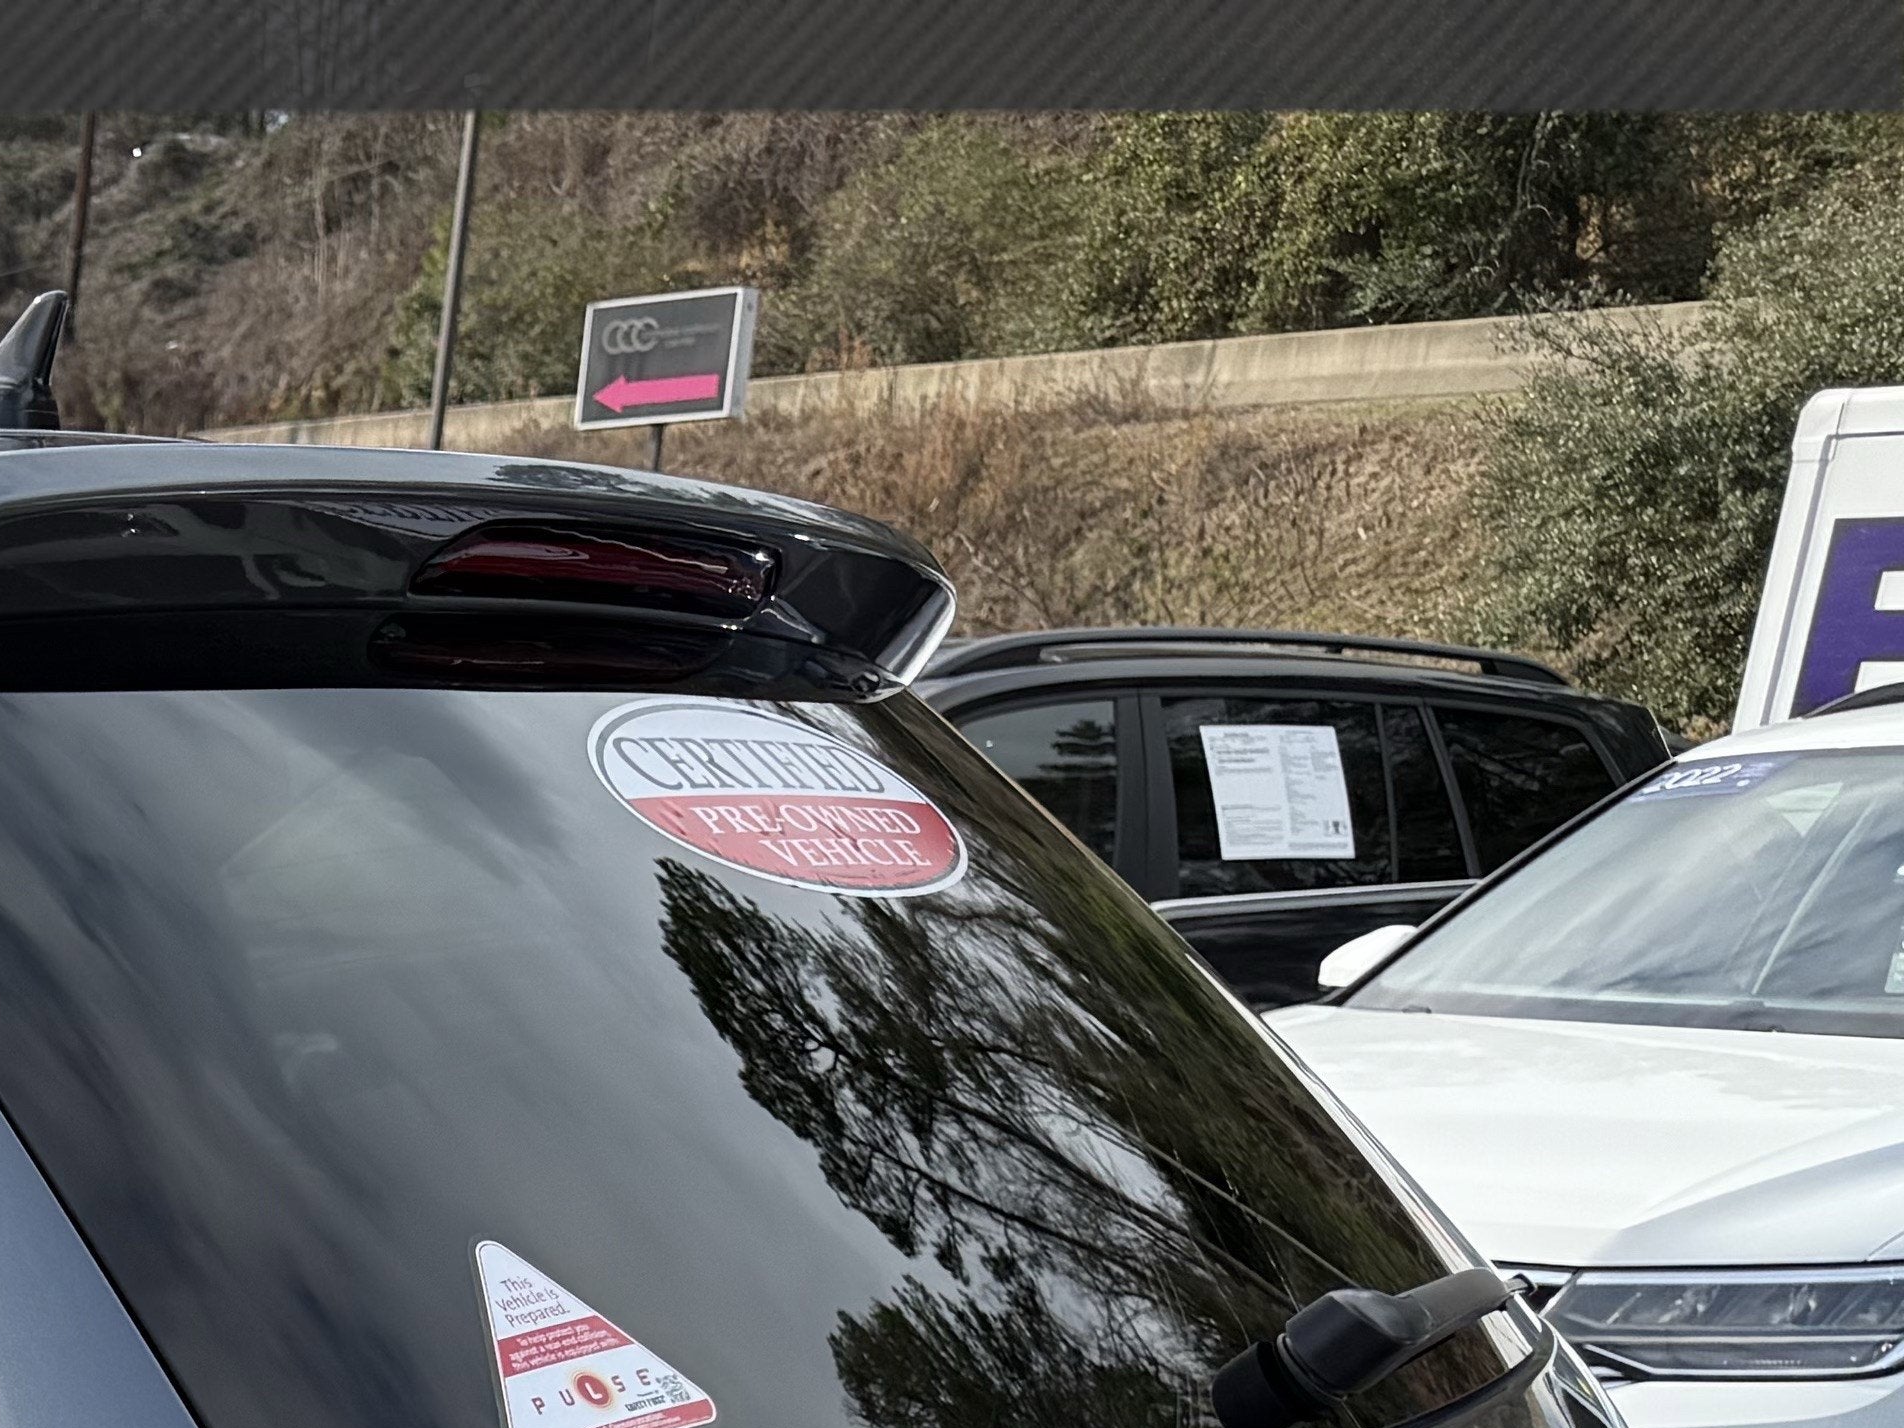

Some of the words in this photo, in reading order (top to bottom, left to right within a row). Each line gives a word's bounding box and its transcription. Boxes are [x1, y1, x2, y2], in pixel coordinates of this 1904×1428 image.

[612, 736, 886, 794] CERTIFIED
[689, 804, 922, 836] PRE-OWNED
[758, 837, 933, 868] VEHICLE
[500, 1275, 533, 1293] This
[495, 1289, 547, 1313] Vehicle
[505, 1303, 571, 1328] Prepared.
[531, 1367, 651, 1415] PULSE
